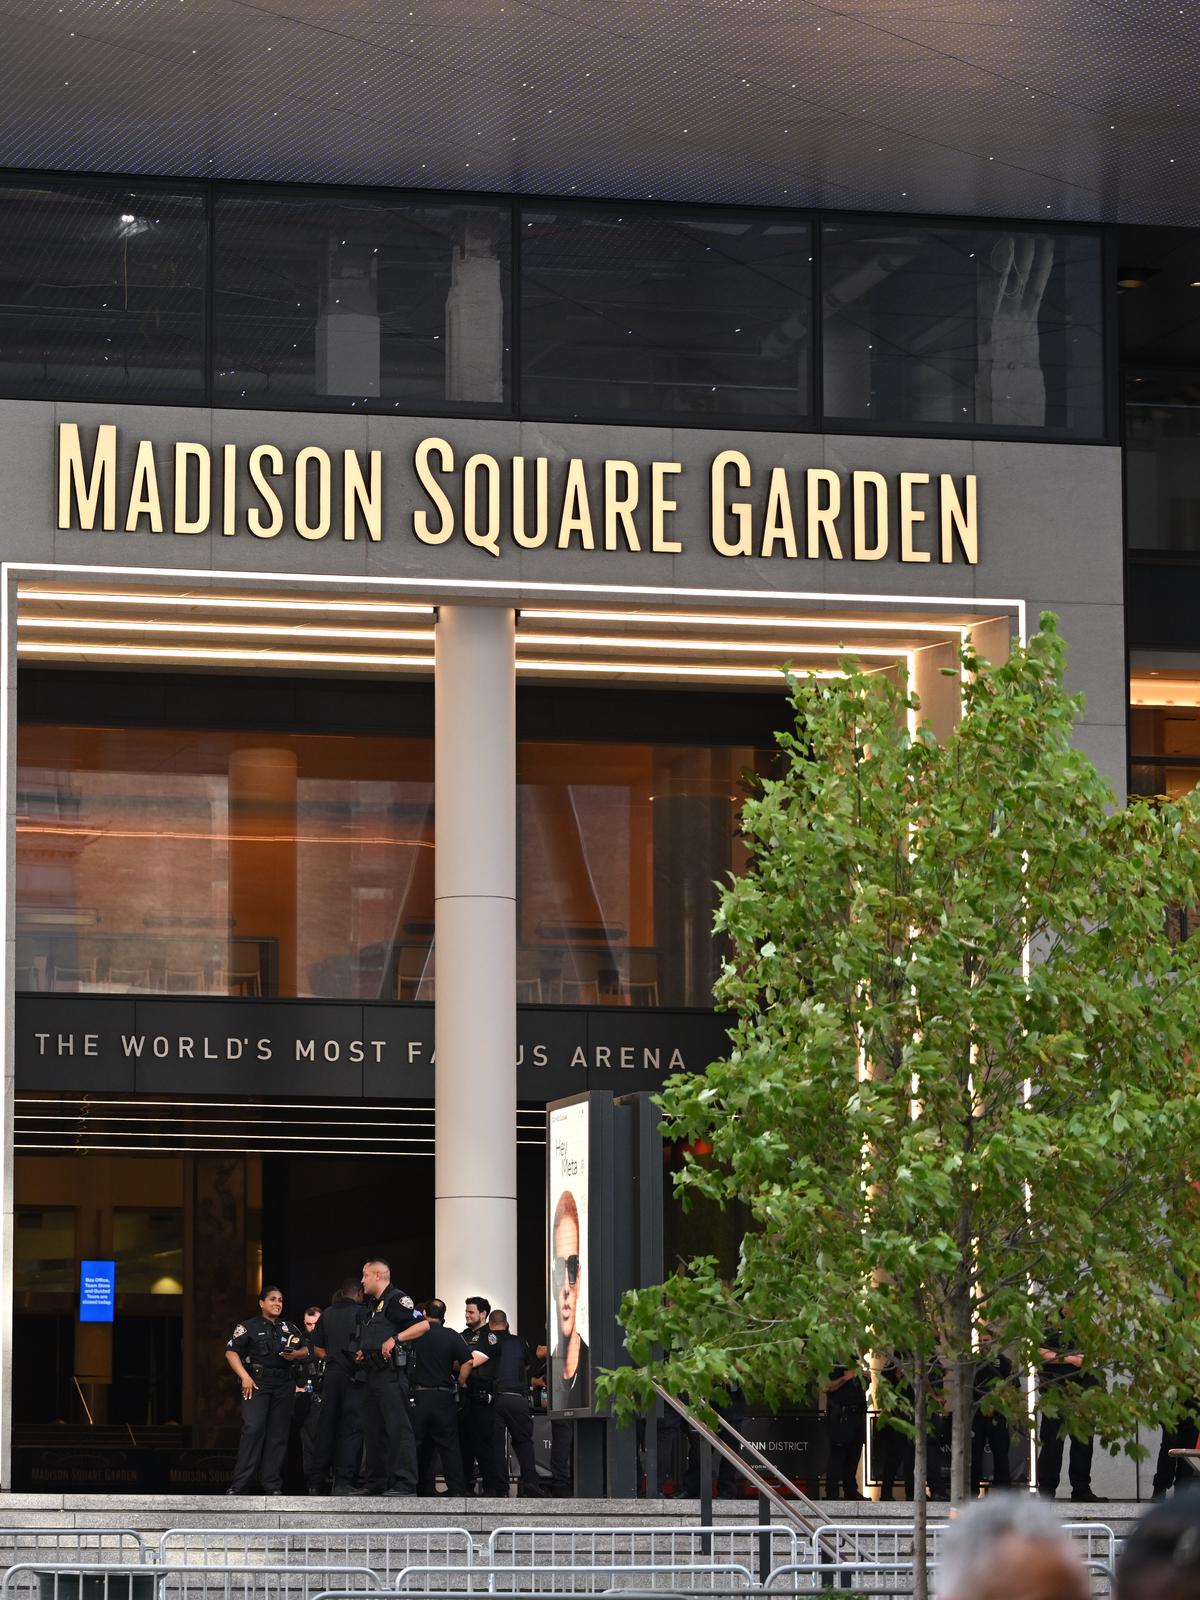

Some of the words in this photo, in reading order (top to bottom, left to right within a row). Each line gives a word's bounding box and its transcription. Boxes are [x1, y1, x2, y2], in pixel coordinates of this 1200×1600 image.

[57, 422, 383, 542] MADISON
[413, 437, 683, 558] SQUARE
[710, 448, 979, 565] GARDEN
[34, 1033, 99, 1056] THE
[121, 1035, 273, 1061] WORLD'S
[295, 1039, 386, 1063] MOST
[570, 1046, 686, 1070] ARENA
[555, 1139, 568, 1161] Hey
[561, 1159, 577, 1177] Meta
[768, 1441, 809, 1451] DISTRICT
